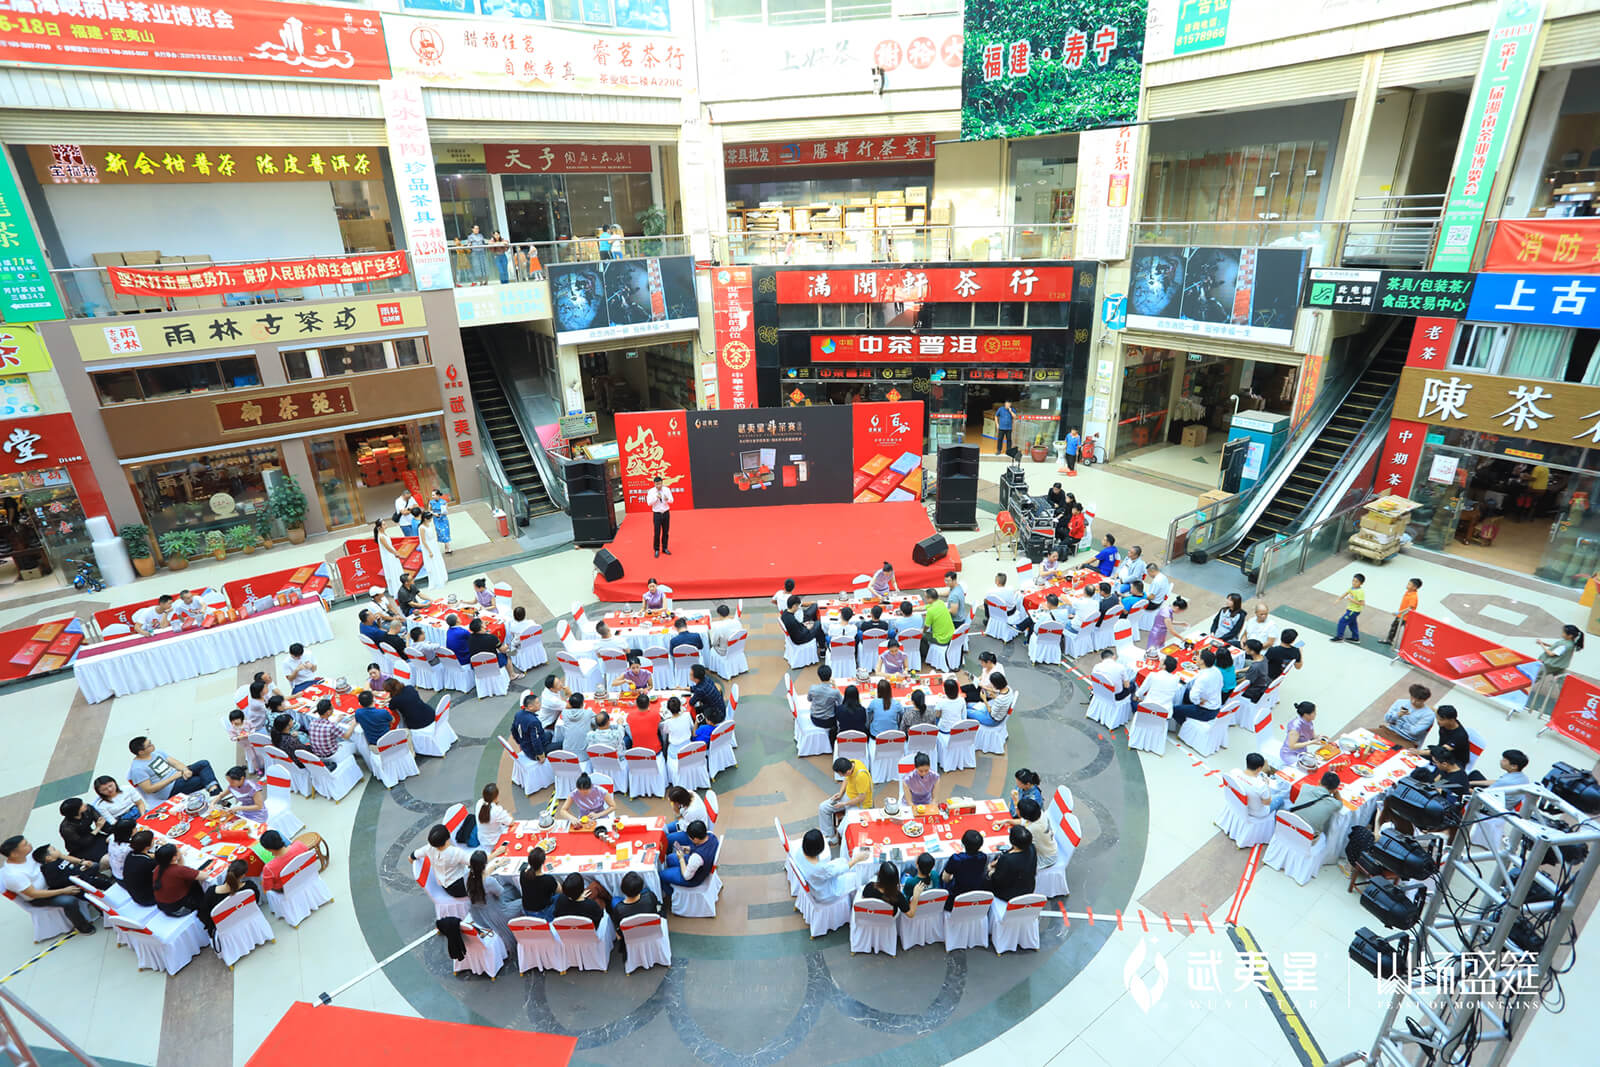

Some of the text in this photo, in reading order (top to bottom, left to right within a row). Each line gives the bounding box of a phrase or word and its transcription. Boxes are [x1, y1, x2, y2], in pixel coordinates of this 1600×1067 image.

[1382, 293, 1467, 312] 食品交易中心
[1495, 280, 1598, 315] 上古
[859, 336, 978, 355] 中茶普洱
[1419, 326, 1443, 360] 老茶
[1386, 430, 1413, 486] 中期茶
